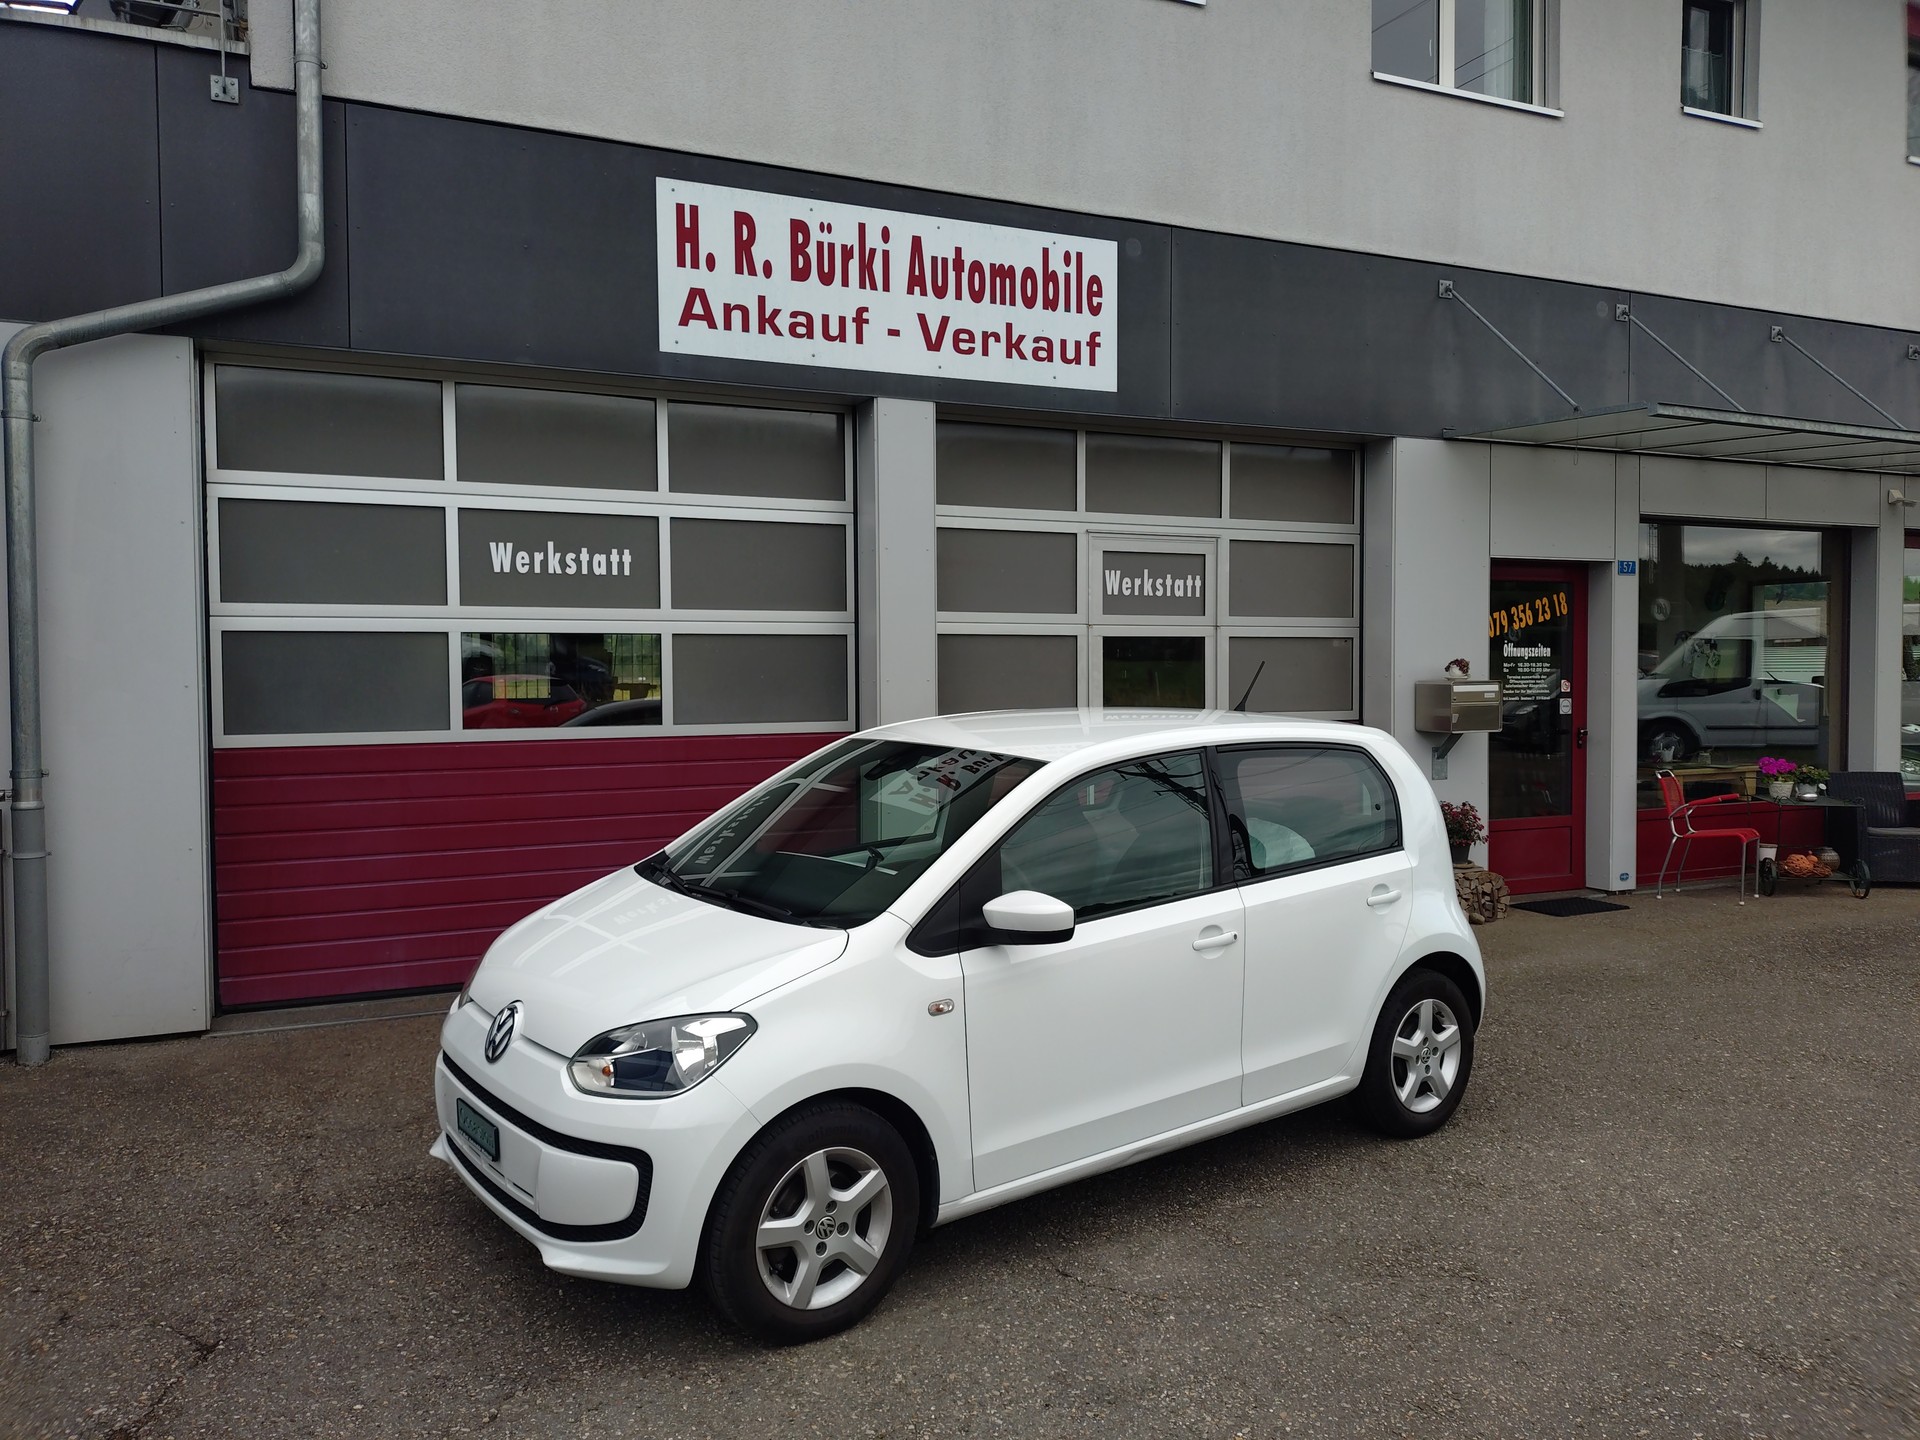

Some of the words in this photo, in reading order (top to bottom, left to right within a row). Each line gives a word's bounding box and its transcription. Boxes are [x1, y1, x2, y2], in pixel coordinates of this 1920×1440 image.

[675, 202, 716, 272] H.
[734, 210, 773, 280] R.
[790, 218, 891, 293] Bürki
[906, 235, 1103, 317] Automobile
[678, 287, 870, 345] Ankauf
[917, 312, 1101, 367] Verkauf
[489, 541, 632, 576] Werkstatt
[1623, 562, 1633, 573] 57
[1104, 569, 1202, 598] Werkstatt
[1511, 602, 1533, 630] 356
[1535, 597, 1551, 623] 23
[1553, 592, 1568, 617] 18
[1503, 640, 1551, 660] Öffnungszeiten
